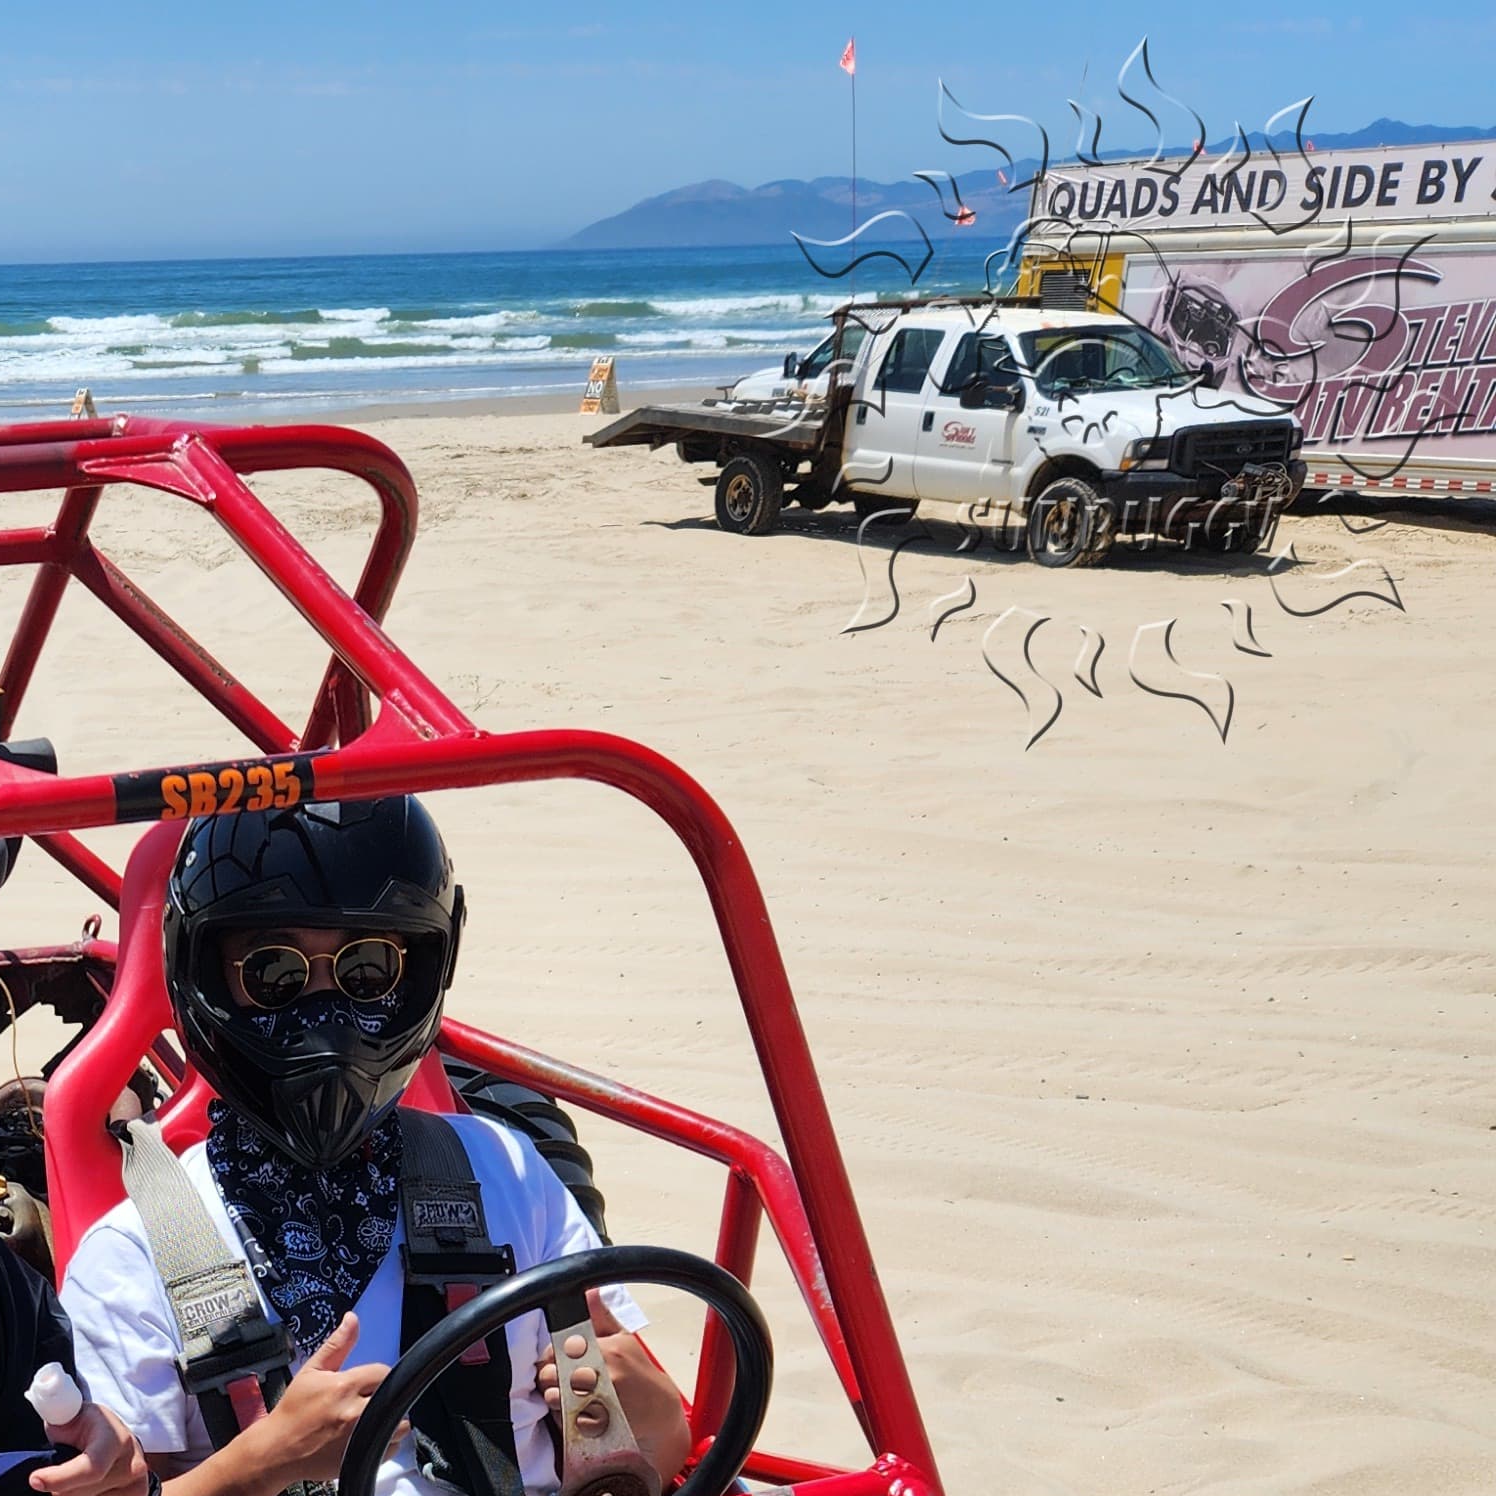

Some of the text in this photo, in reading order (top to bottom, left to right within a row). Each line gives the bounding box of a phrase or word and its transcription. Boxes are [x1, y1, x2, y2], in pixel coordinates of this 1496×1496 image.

[1048, 156, 1483, 219] QUADS AND SIDE BY
[160, 760, 303, 821] SB235
[184, 1293, 231, 1321] CROW
